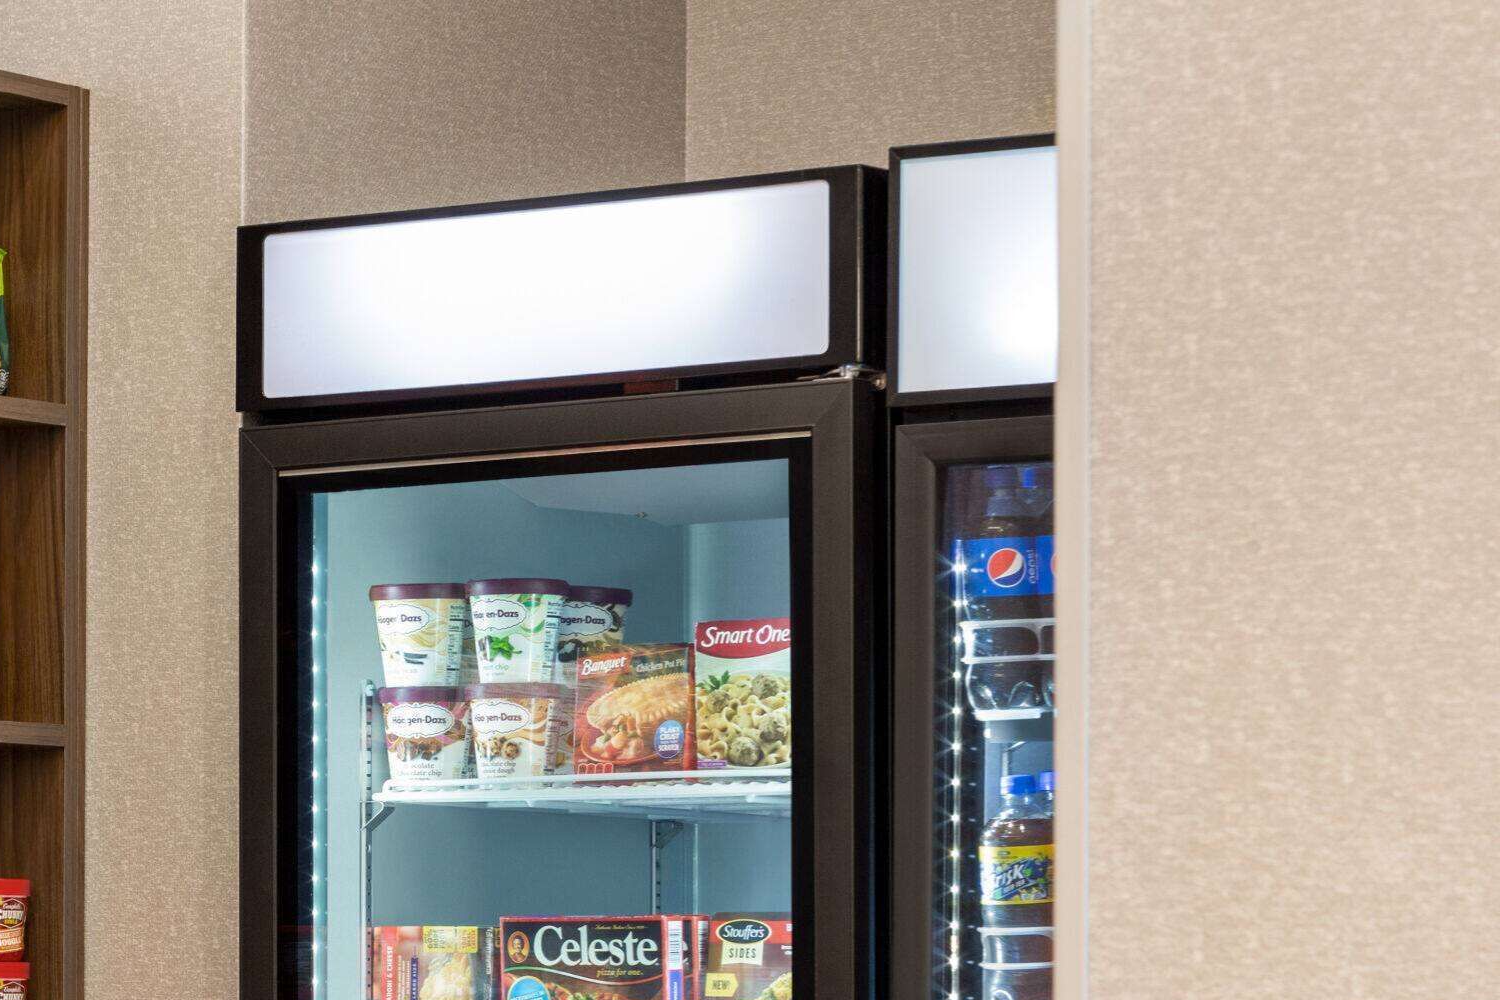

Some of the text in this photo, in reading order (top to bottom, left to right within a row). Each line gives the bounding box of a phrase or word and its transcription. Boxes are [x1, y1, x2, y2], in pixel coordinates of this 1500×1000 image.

[701, 625, 753, 648] Smart
[580, 656, 628, 676] Banquet
[636, 660, 675, 673] Chicken Pot
[723, 924, 765, 942] Stouffer's
[533, 924, 659, 967] Celeste
[728, 948, 756, 958] SIDES
[385, 944, 393, 972] CHEESE
[596, 967, 642, 978] pizza for one
